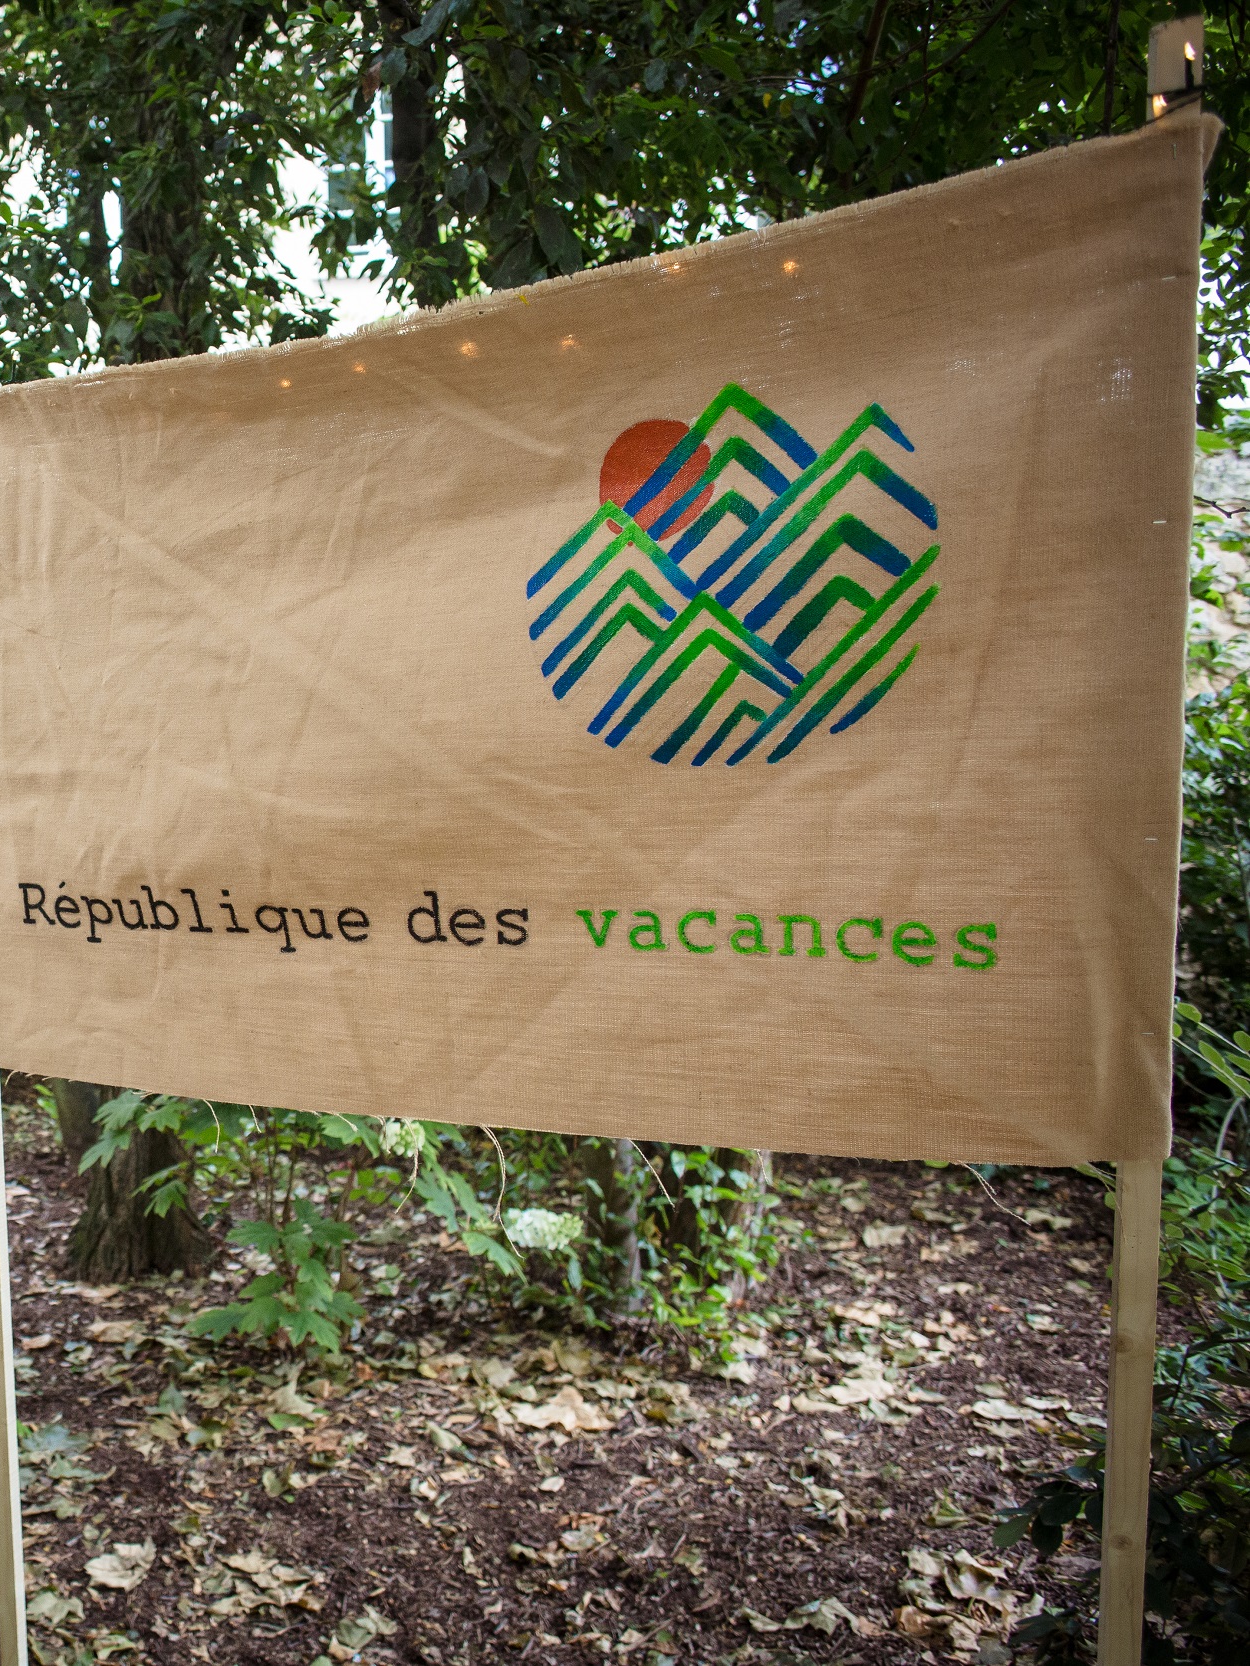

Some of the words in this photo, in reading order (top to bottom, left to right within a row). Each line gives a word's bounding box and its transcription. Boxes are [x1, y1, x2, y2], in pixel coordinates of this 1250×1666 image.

[18, 881, 371, 954] République
[407, 890, 530, 947] des
[575, 908, 999, 971] vacances
